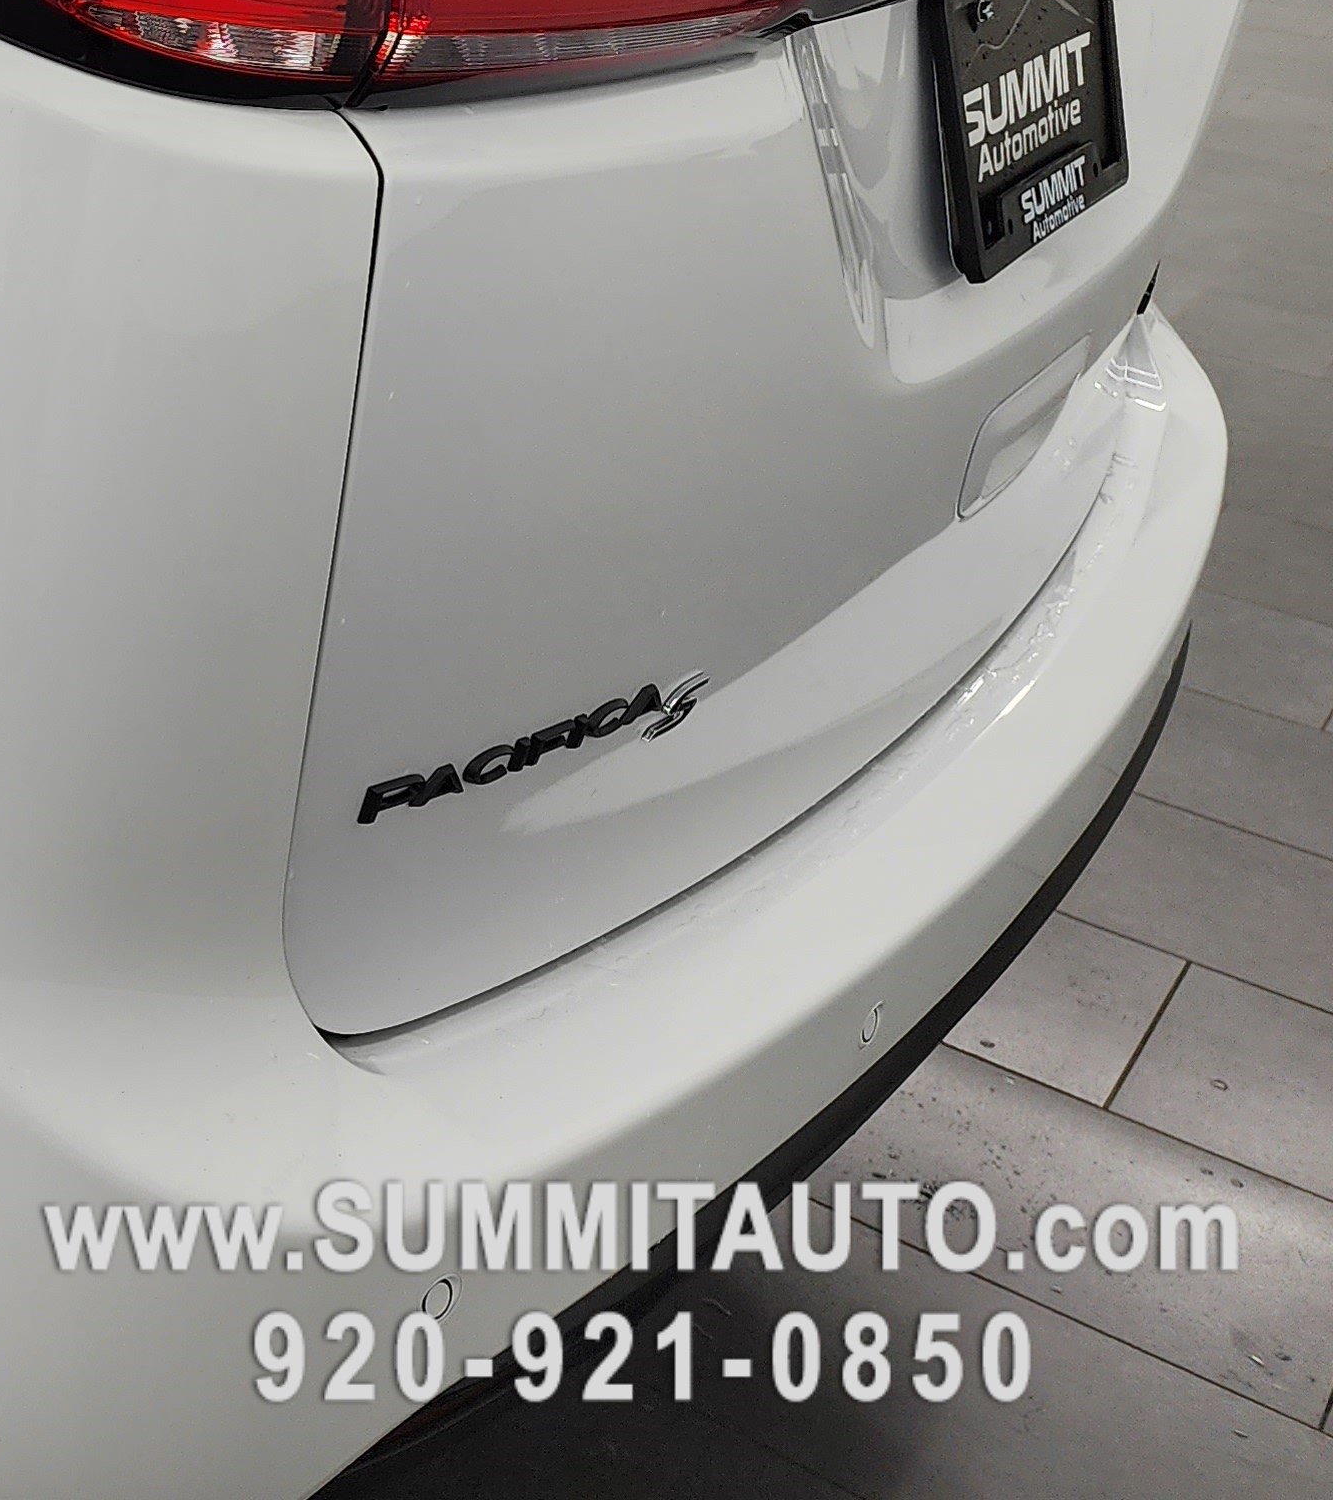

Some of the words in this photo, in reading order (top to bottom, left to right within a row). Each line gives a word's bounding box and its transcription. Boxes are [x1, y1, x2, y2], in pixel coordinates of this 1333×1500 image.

[963, 31, 1091, 147] SUMMIT
[977, 97, 1082, 183] Automotive
[1020, 155, 1086, 225] SUMMIT
[1033, 193, 1086, 243] Automotive
[357, 683, 662, 825] PACIFICA
[641, 671, 711, 743] S
